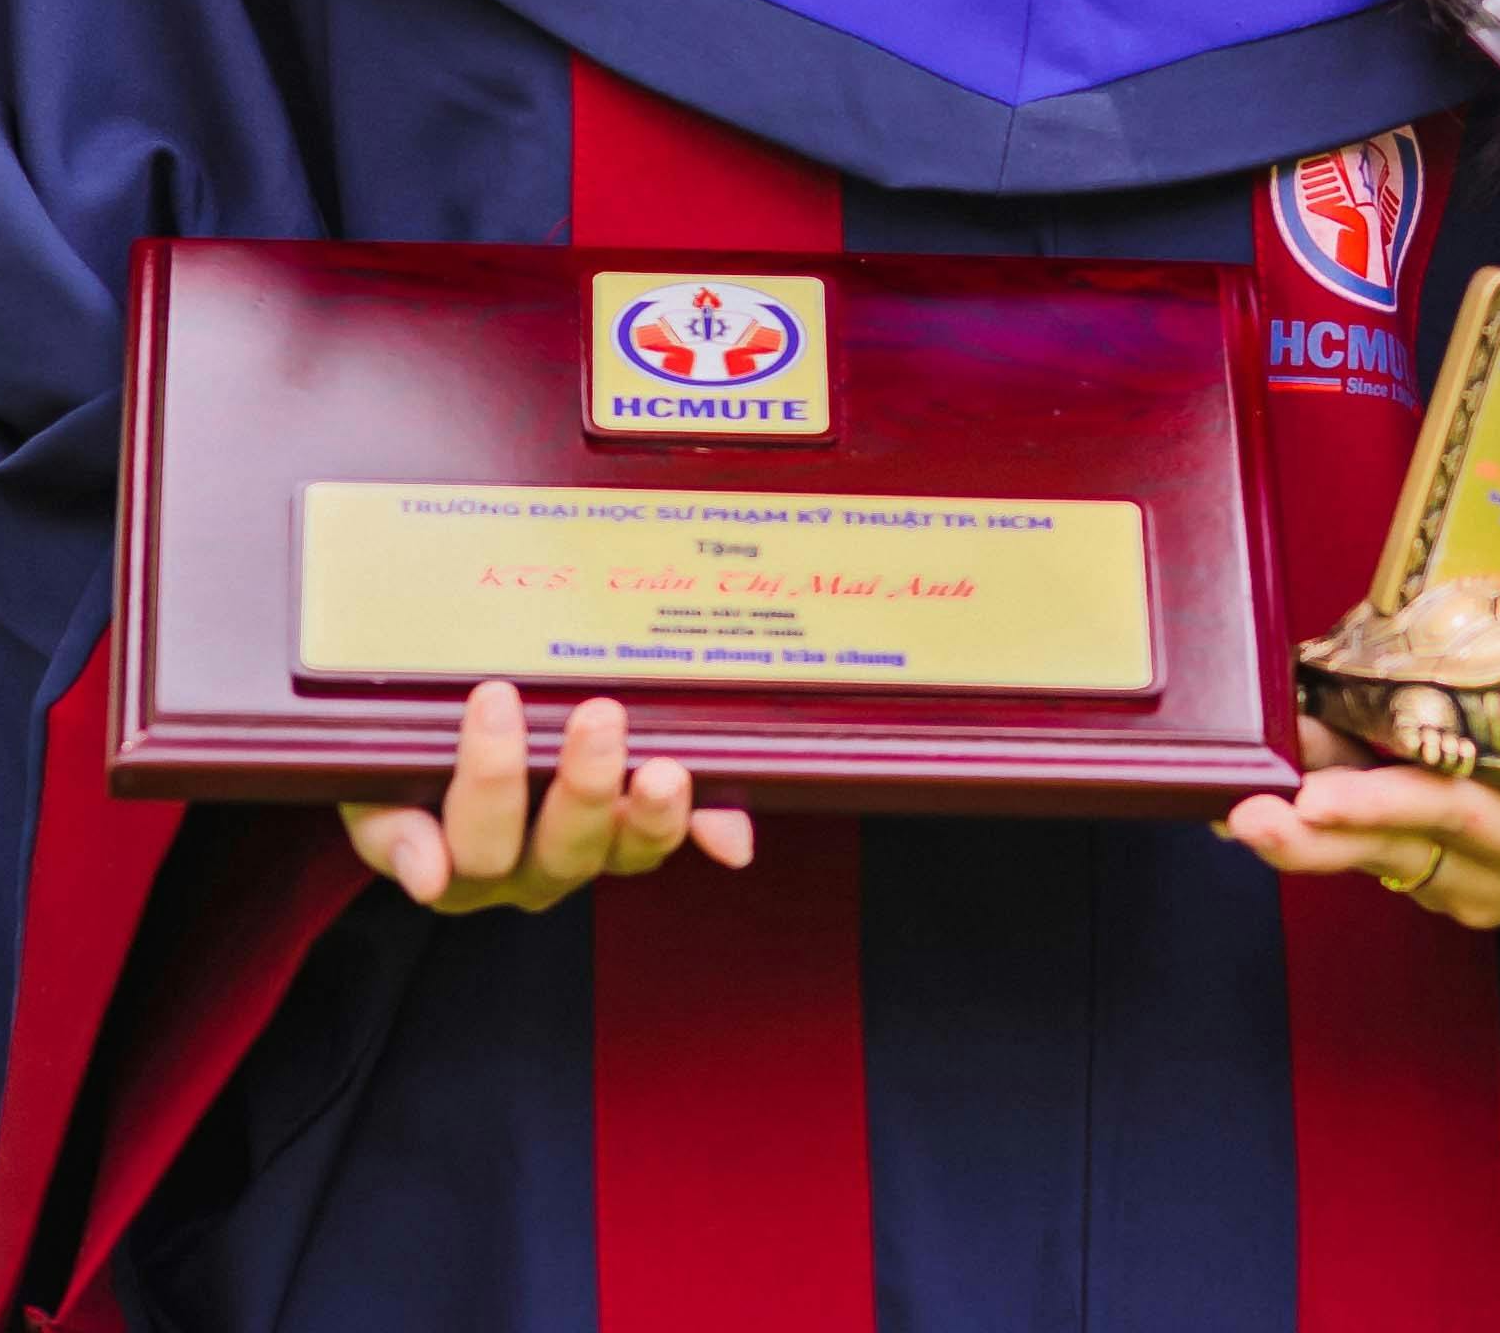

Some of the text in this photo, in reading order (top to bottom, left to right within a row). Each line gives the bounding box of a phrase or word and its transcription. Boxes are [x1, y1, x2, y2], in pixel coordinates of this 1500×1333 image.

[1346, 376, 1390, 397] Since
[614, 398, 808, 420] HCMUTE
[789, 573, 882, 596] Mai
